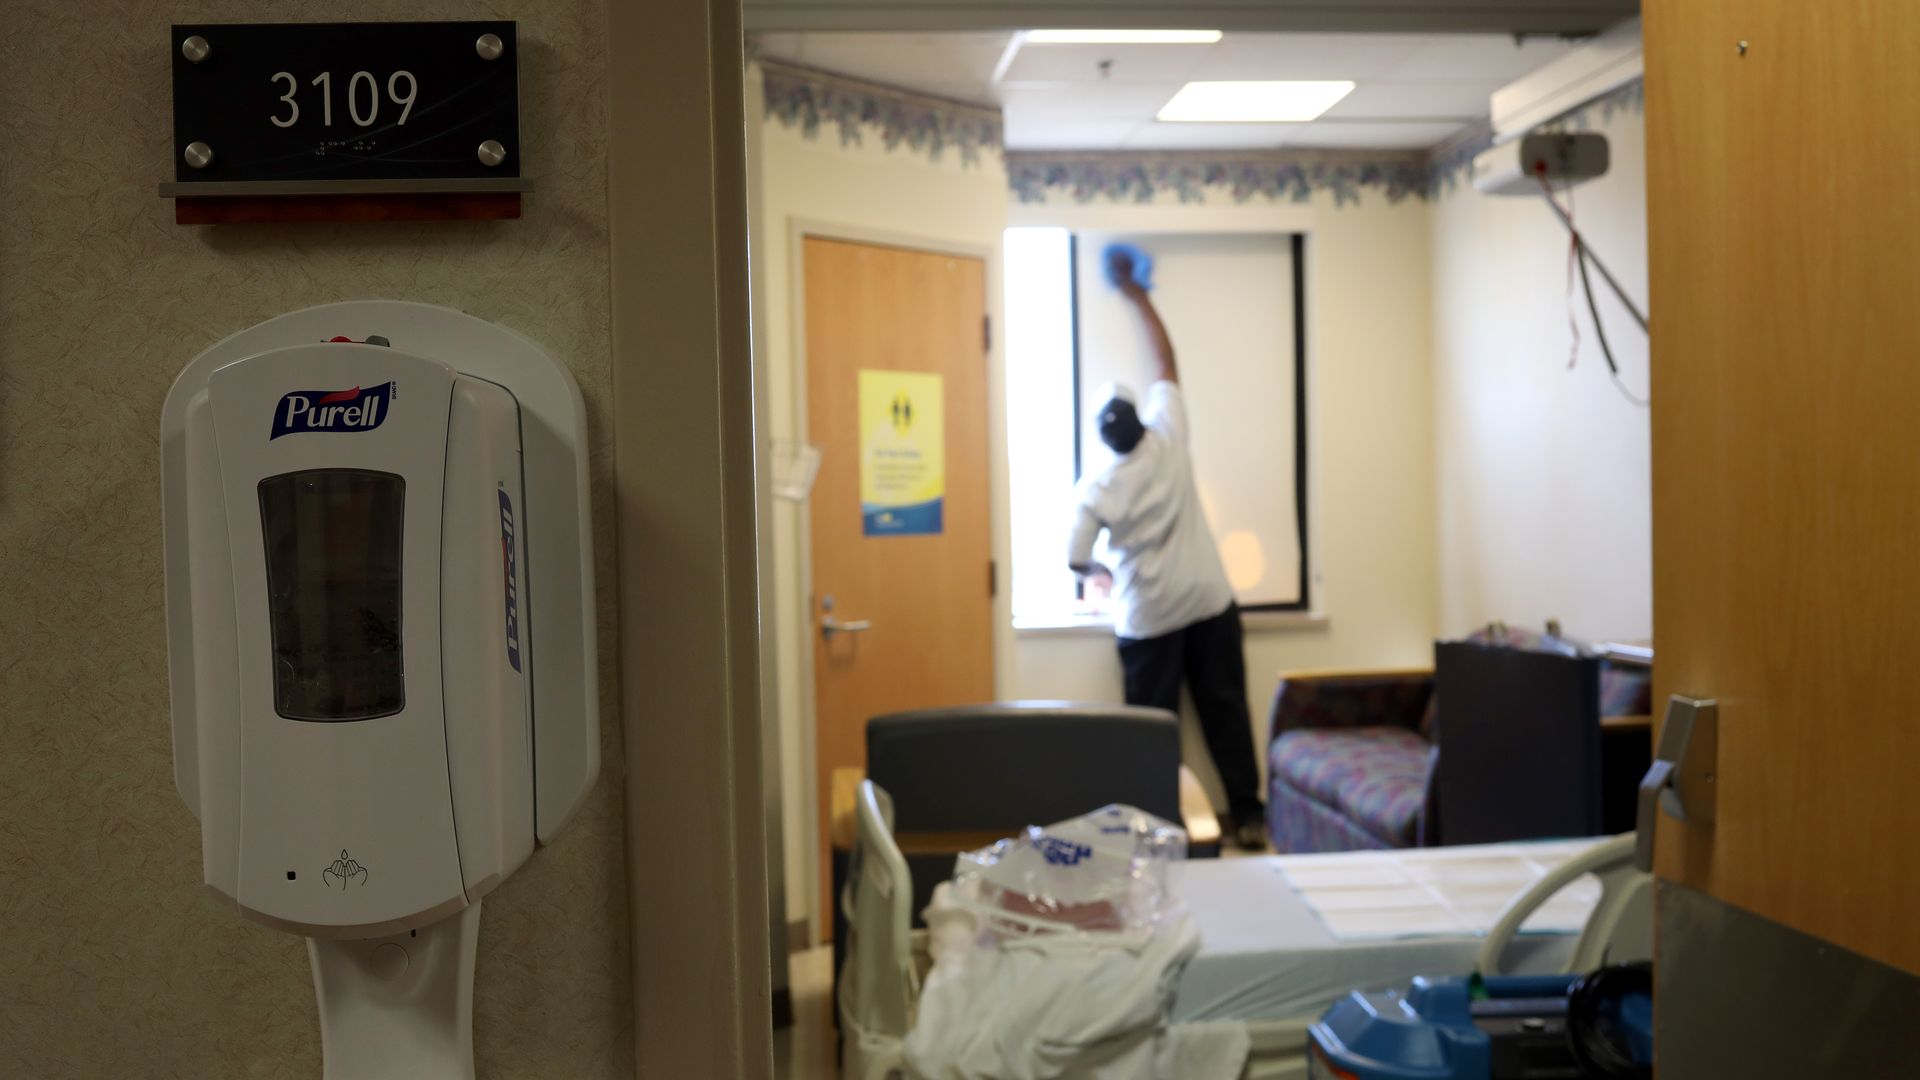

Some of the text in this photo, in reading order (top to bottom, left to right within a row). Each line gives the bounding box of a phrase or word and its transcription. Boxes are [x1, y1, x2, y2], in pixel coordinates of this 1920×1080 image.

[269, 70, 419, 128] 3109
[285, 395, 380, 428] Purell
[502, 507, 518, 651] Purell
